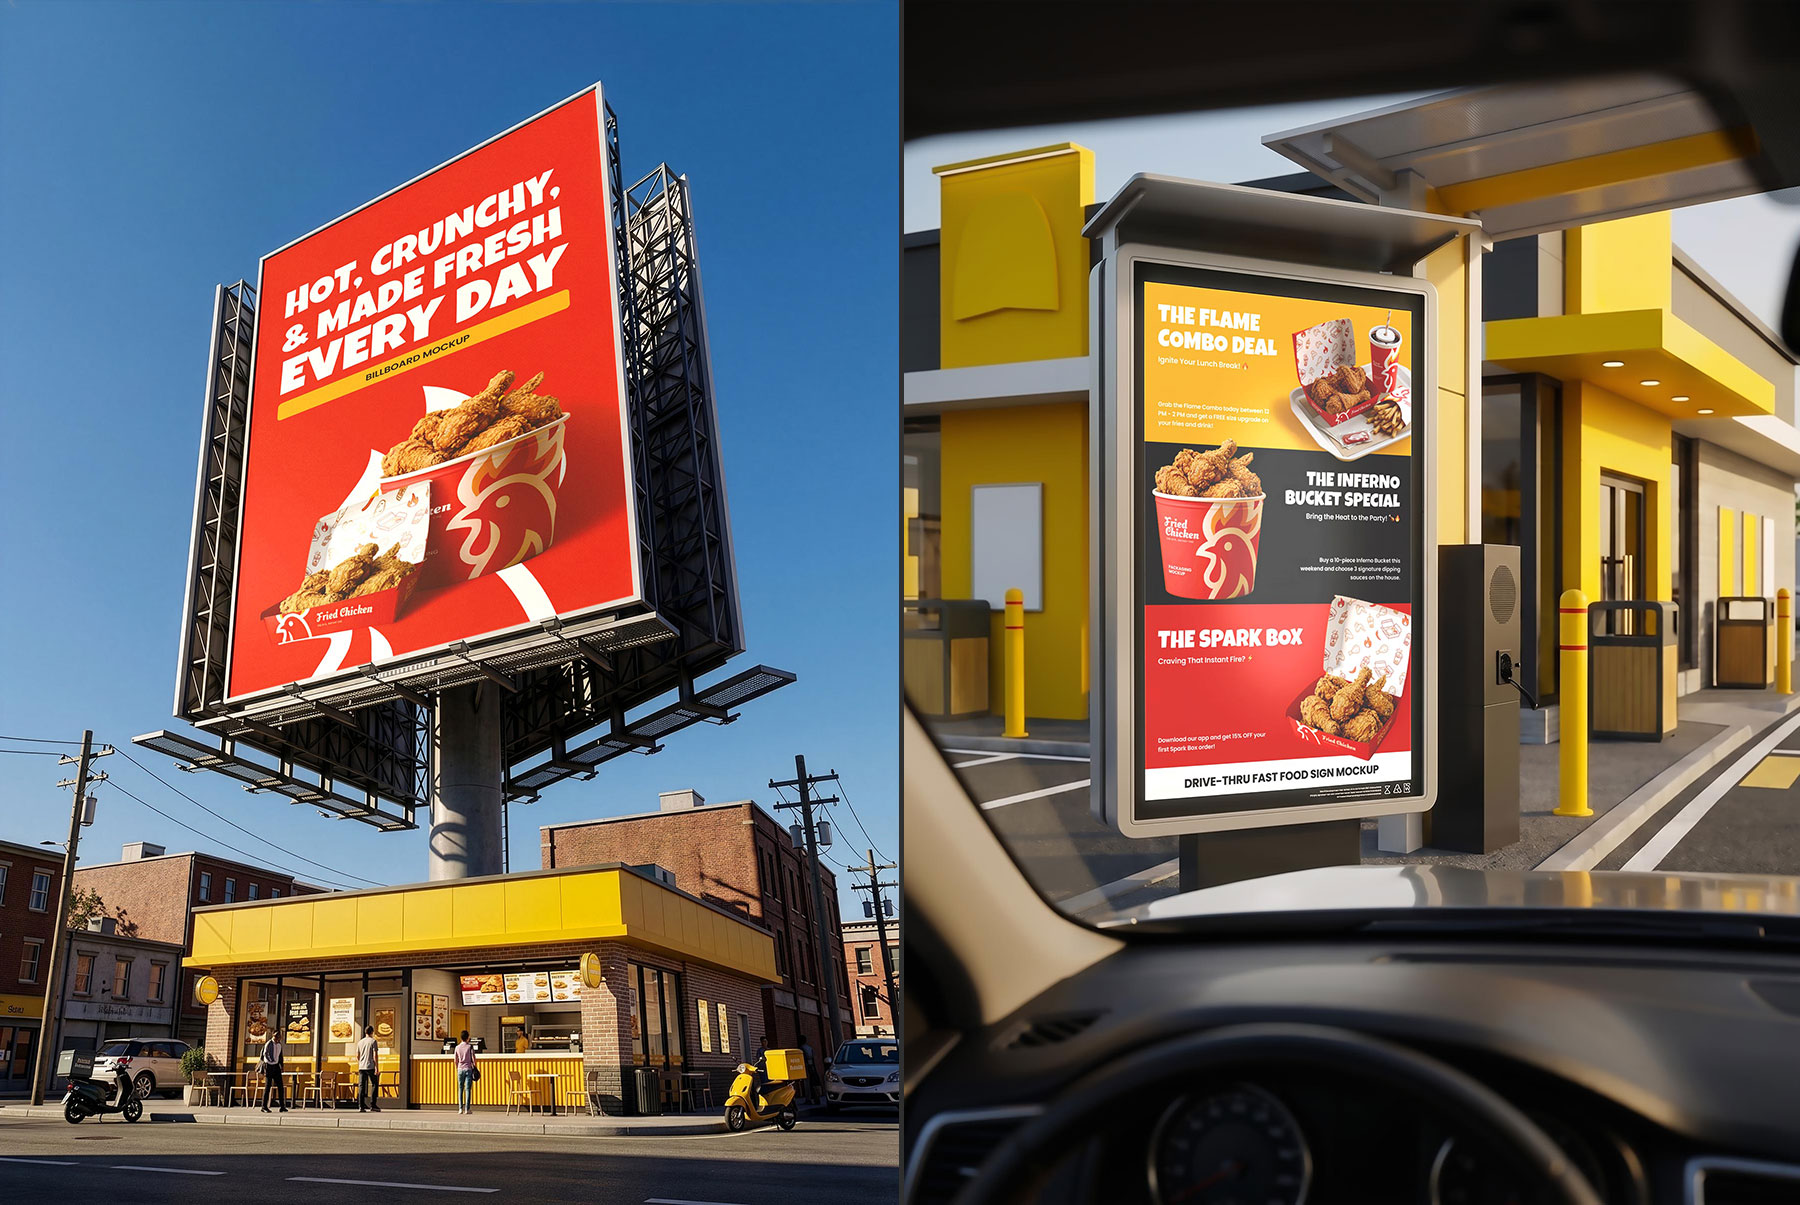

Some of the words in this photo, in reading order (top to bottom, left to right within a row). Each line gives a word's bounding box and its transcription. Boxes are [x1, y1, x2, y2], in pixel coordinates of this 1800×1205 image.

[284, 260, 363, 320] HOT,
[371, 168, 561, 275] CRUNCHY,
[282, 322, 309, 353] &
[317, 273, 423, 340] MADE
[434, 205, 563, 289] FRESH
[280, 294, 445, 396] EVERY
[455, 242, 569, 324] DAY
[1158, 303, 1195, 325] THE
[1200, 308, 1260, 332] FLAME
[1158, 329, 1227, 352] COMBO
[1232, 336, 1277, 356] DEAL
[366, 353, 421, 382] BILLBOARD
[422, 333, 471, 362] MOCKUP
[1158, 356, 1178, 365] Ignite
[1180, 358, 1195, 366] Your
[1197, 359, 1217, 368] Lunch
[1219, 360, 1240, 369] Break!
[1238, 416, 1260, 424] upgrade
[1306, 471, 1334, 488] THE
[1337, 472, 1400, 489] INFERNO
[1285, 489, 1341, 507] BUCKET
[1345, 491, 1400, 508] SPECIAL
[1164, 516, 1188, 529] Fried
[1305, 513, 1323, 522] Bring
[1369, 515, 1387, 523] Party!
[1165, 527, 1199, 540] Chicken
[316, 609, 338, 622] Fried
[340, 604, 373, 617] Chicken
[1158, 629, 1195, 648] THE
[1199, 628, 1262, 648] SPARK
[1266, 627, 1304, 646] BOX
[1158, 657, 1186, 666] Craving
[1222, 733, 1231, 741] get
[1321, 734, 1335, 744] Fried
[1170, 745, 1186, 753] Spark
[1184, 774, 1250, 789] DRIVE-THRU
[1252, 771, 1278, 784] FAST
[1280, 769, 1309, 782] FOOD
[1310, 768, 1334, 778] SIGN
[1336, 765, 1379, 777] MOCKUP
